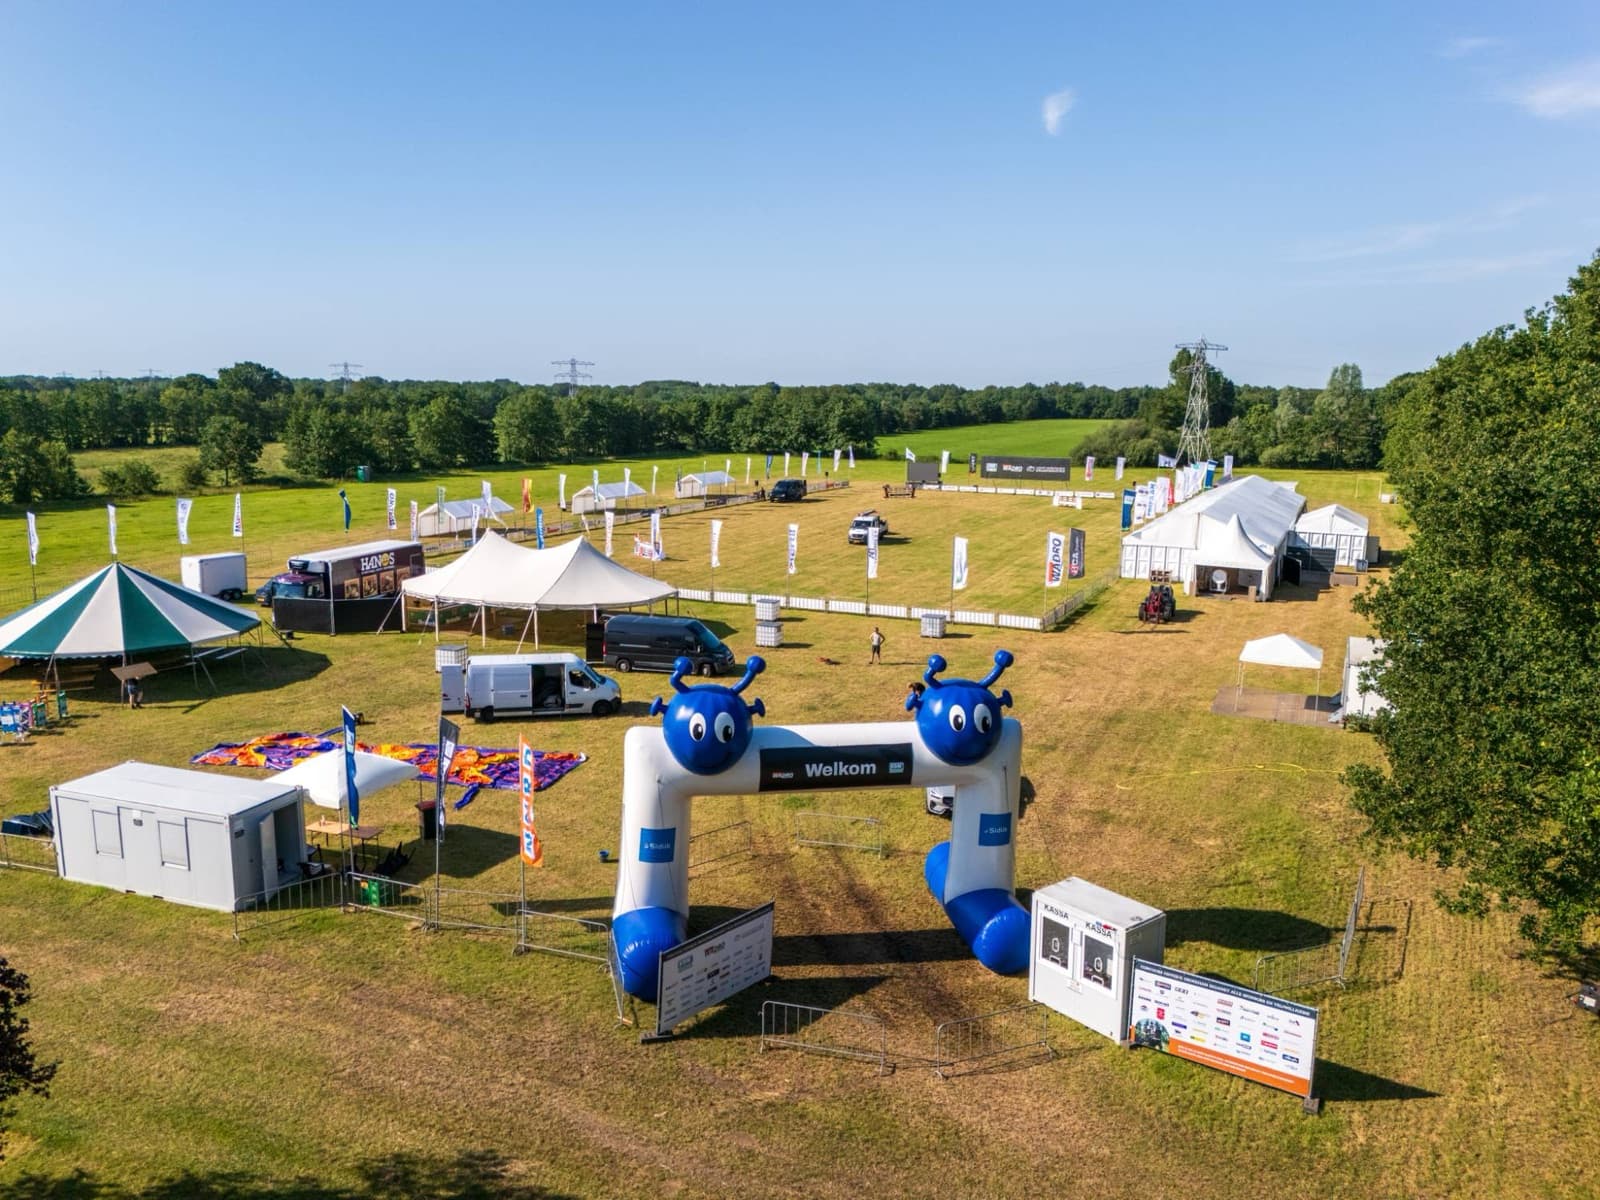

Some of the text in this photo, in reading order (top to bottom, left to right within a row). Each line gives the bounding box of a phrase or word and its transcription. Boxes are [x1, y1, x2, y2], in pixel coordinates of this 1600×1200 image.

[360, 552, 395, 571] HANOS
[1052, 538, 1063, 582] WADRO
[805, 761, 876, 778] Welkom
[1043, 904, 1069, 920] KASSA
[1085, 921, 1113, 938] KASSA
